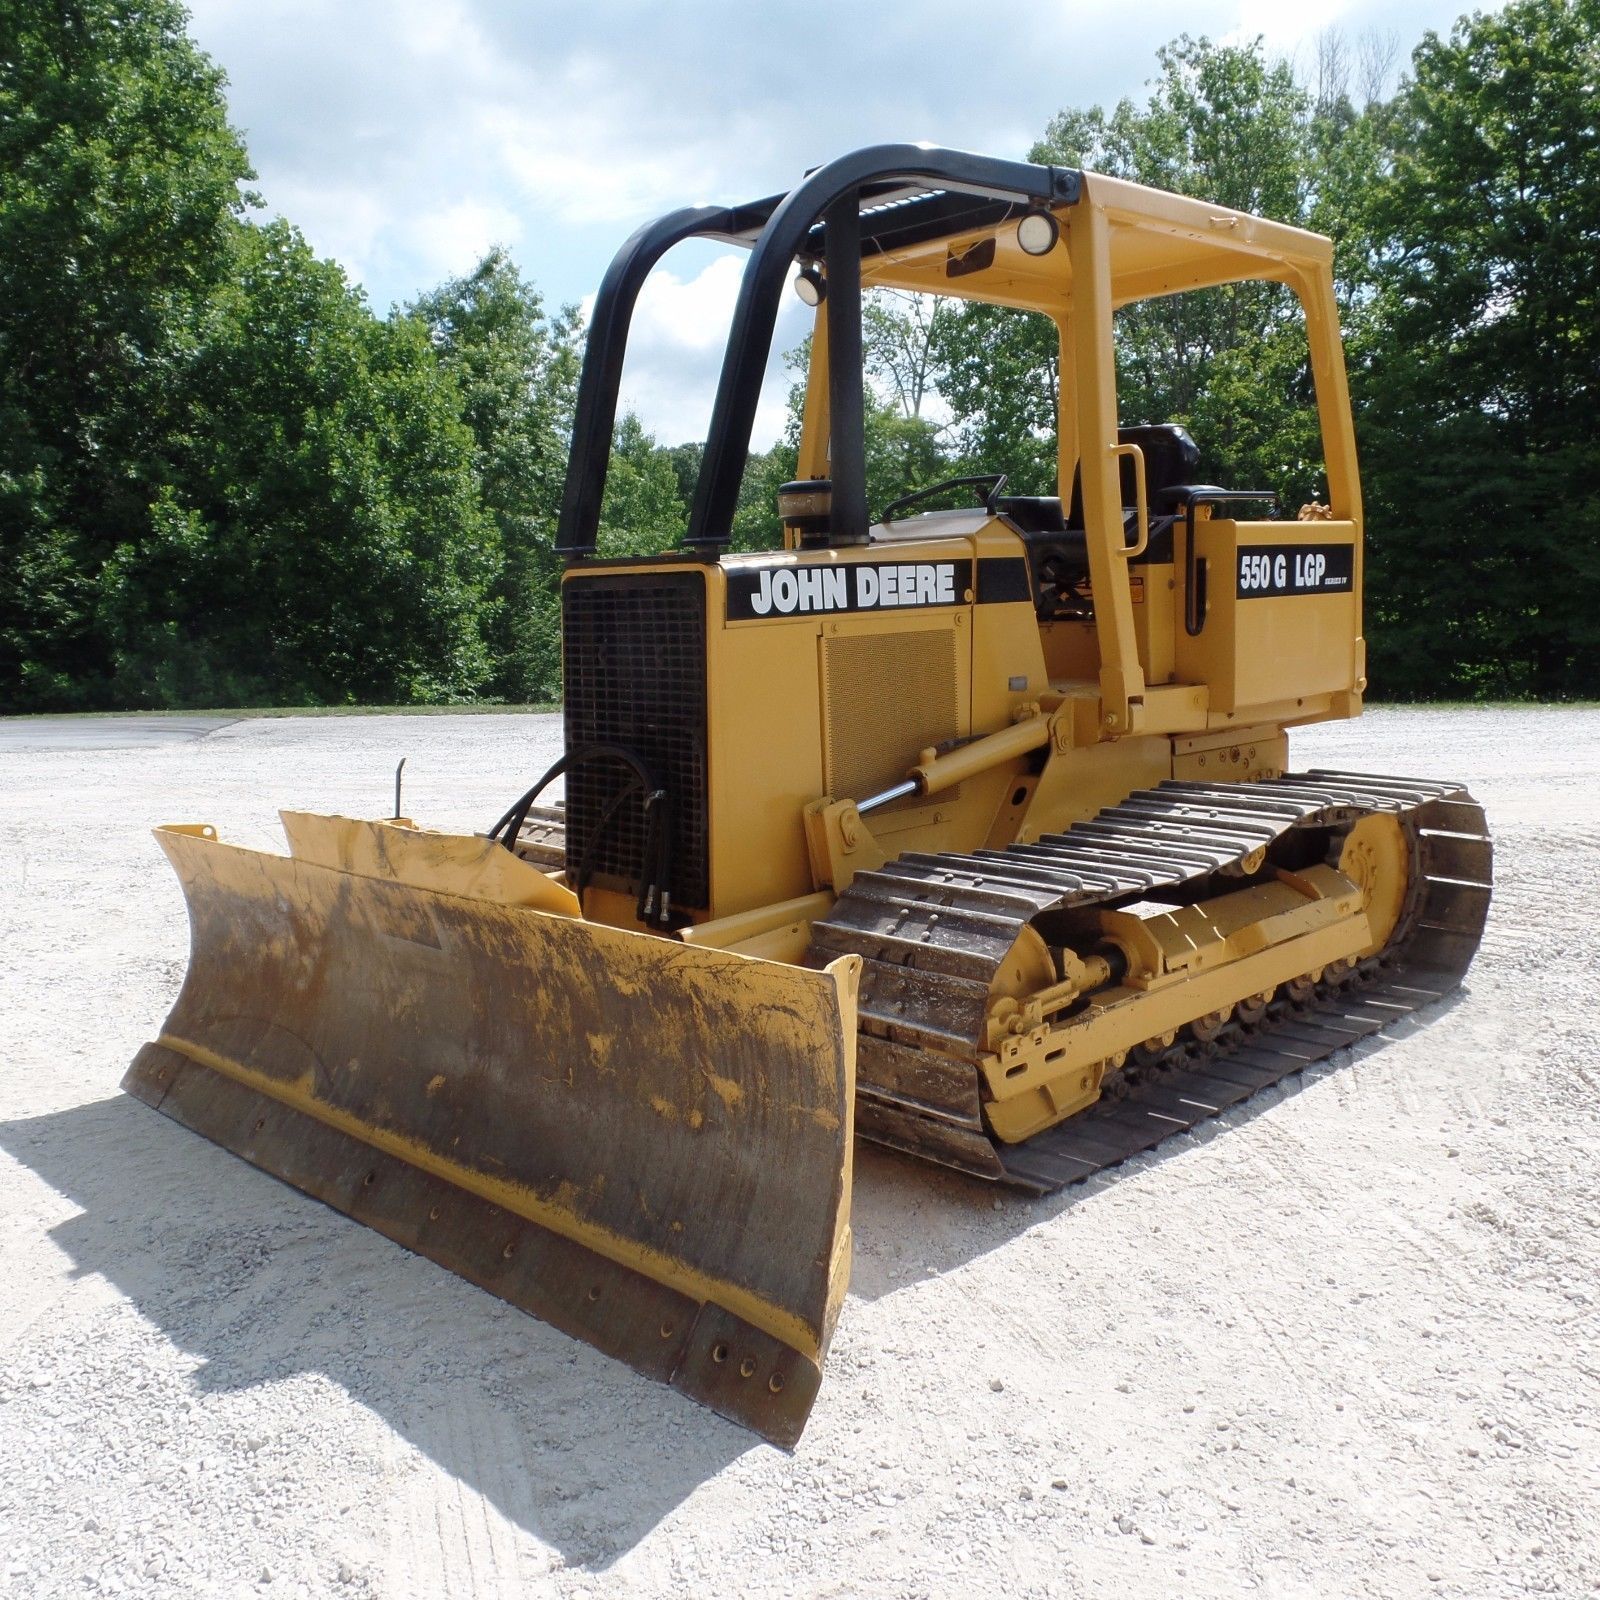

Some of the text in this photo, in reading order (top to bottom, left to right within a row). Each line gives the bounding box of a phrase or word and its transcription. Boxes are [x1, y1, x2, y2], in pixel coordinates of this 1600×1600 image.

[751, 564, 955, 614] JOHN DEERE
[1240, 553, 1326, 589] 550 G LGP
